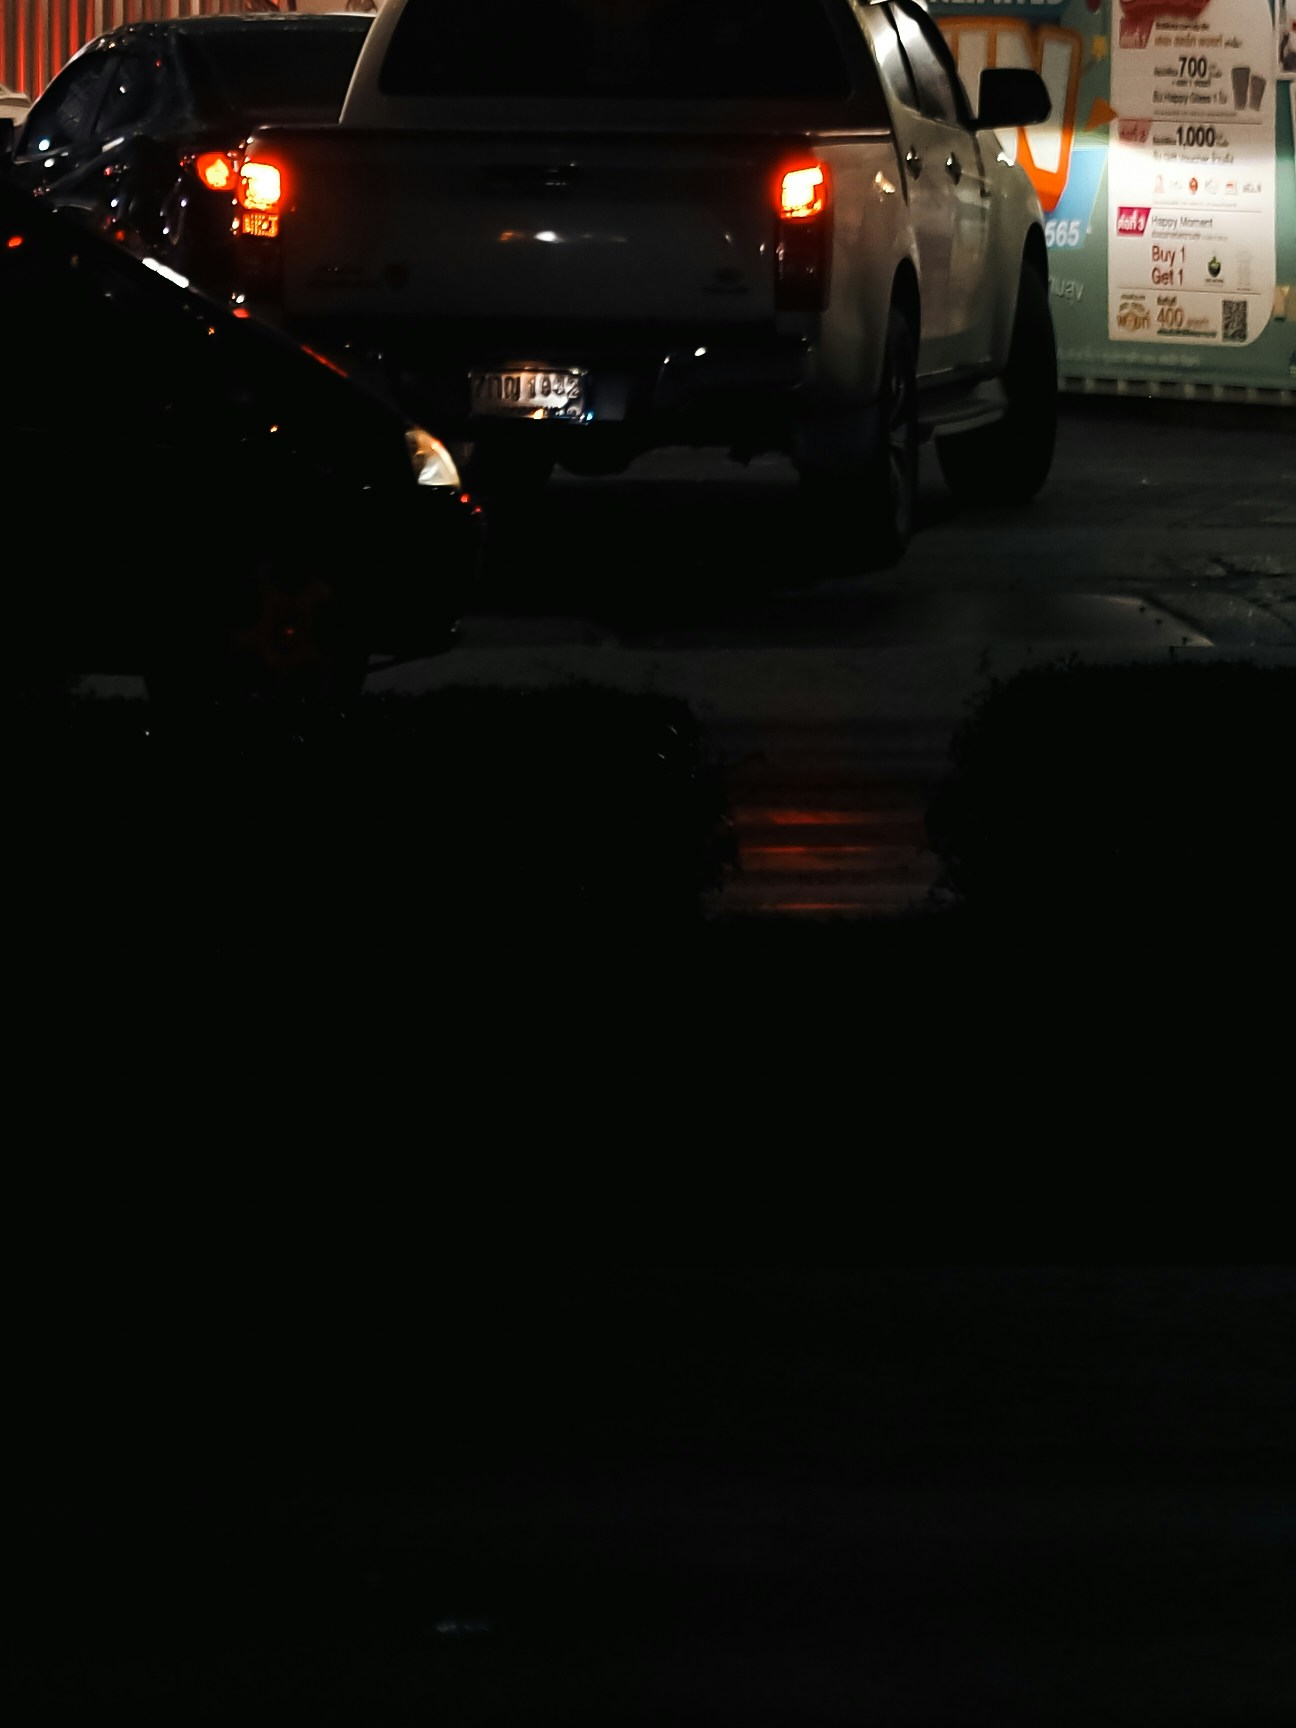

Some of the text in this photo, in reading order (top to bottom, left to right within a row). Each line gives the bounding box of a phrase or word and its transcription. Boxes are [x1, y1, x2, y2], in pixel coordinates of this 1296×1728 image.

[1178, 55, 1208, 78] 700
[1177, 125, 1216, 149] 1,000
[1151, 245, 1186, 267] Buy 1
[1151, 267, 1177, 286] Get
[1179, 268, 1184, 286] 1
[1157, 307, 1184, 328] 400
